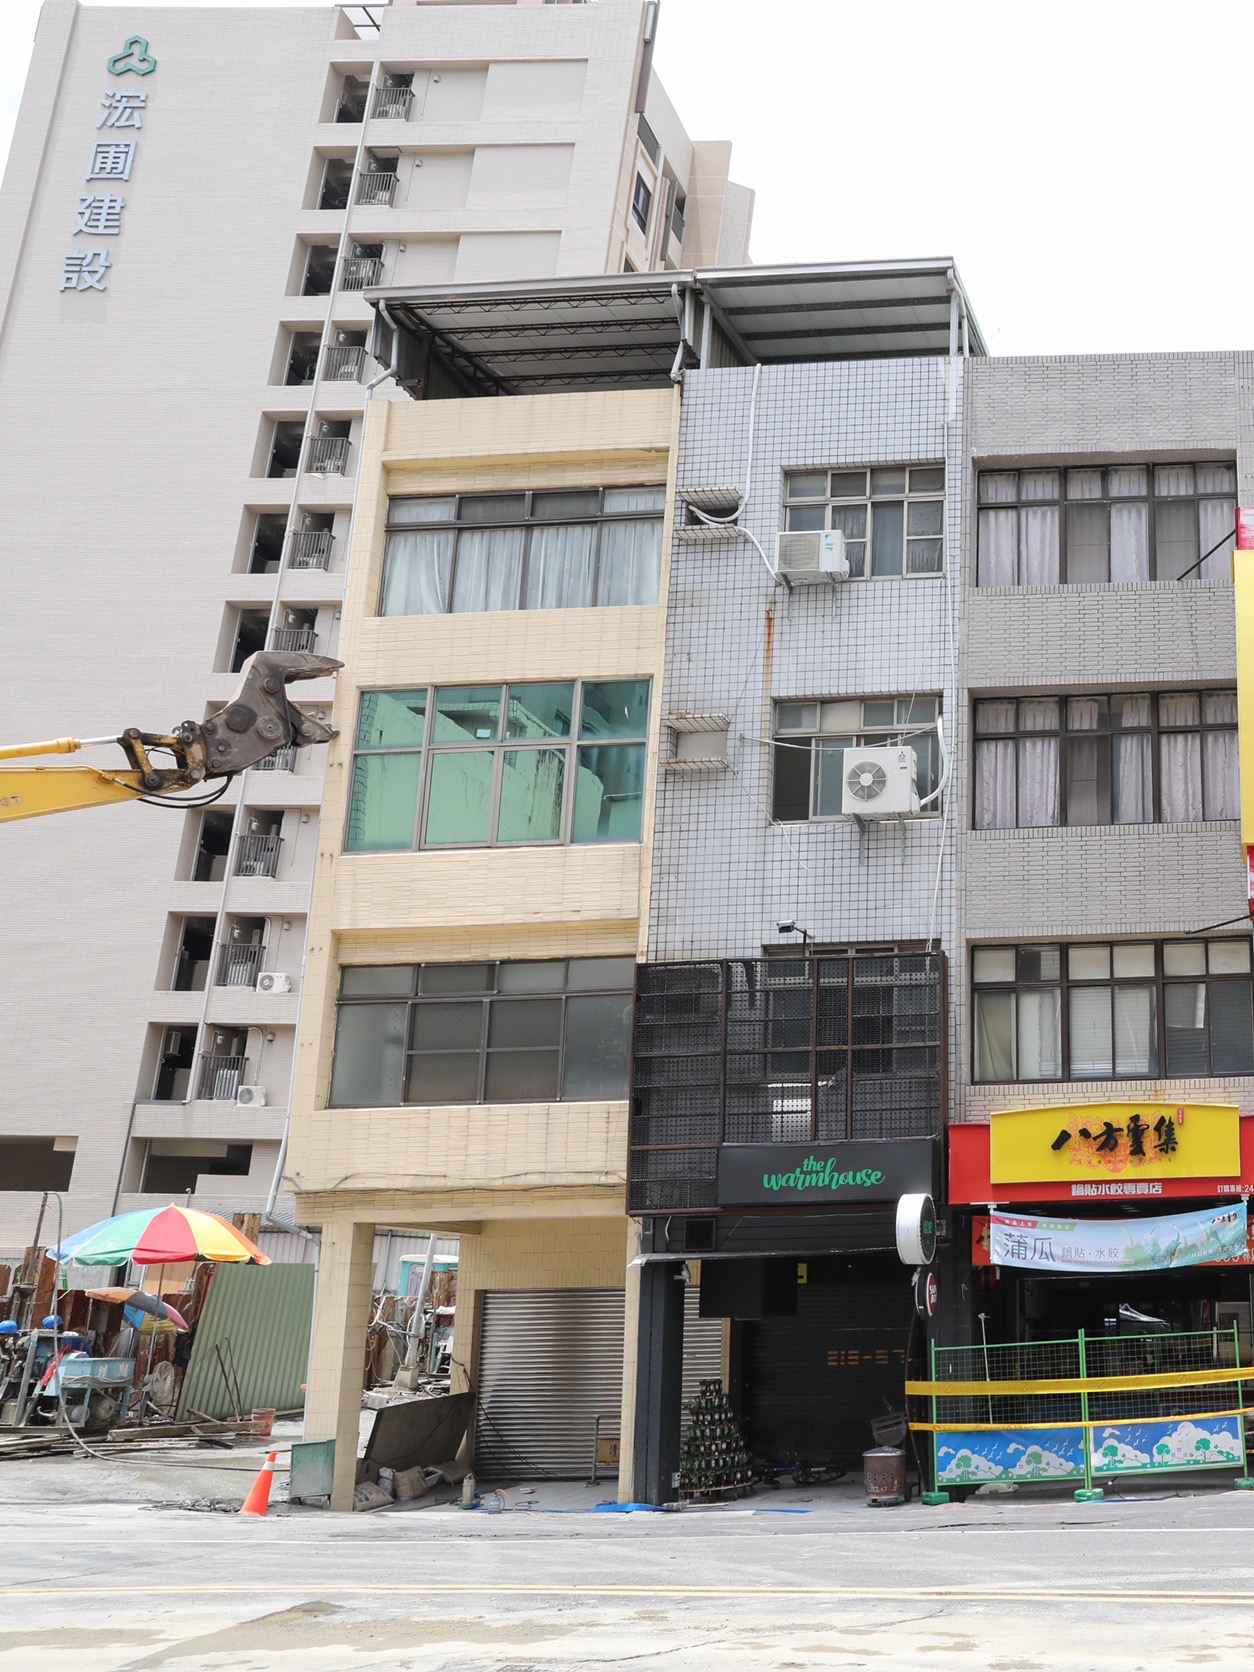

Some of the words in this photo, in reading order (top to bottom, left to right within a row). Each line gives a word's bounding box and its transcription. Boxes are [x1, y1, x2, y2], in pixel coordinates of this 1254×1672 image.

[763, 1157, 886, 1191] warmhouse
[802, 1155, 825, 1172] the
[1070, 1182, 1163, 1197] 鍋貼水餃專賣店
[1003, 1231, 1057, 1264] 蒲瓜
